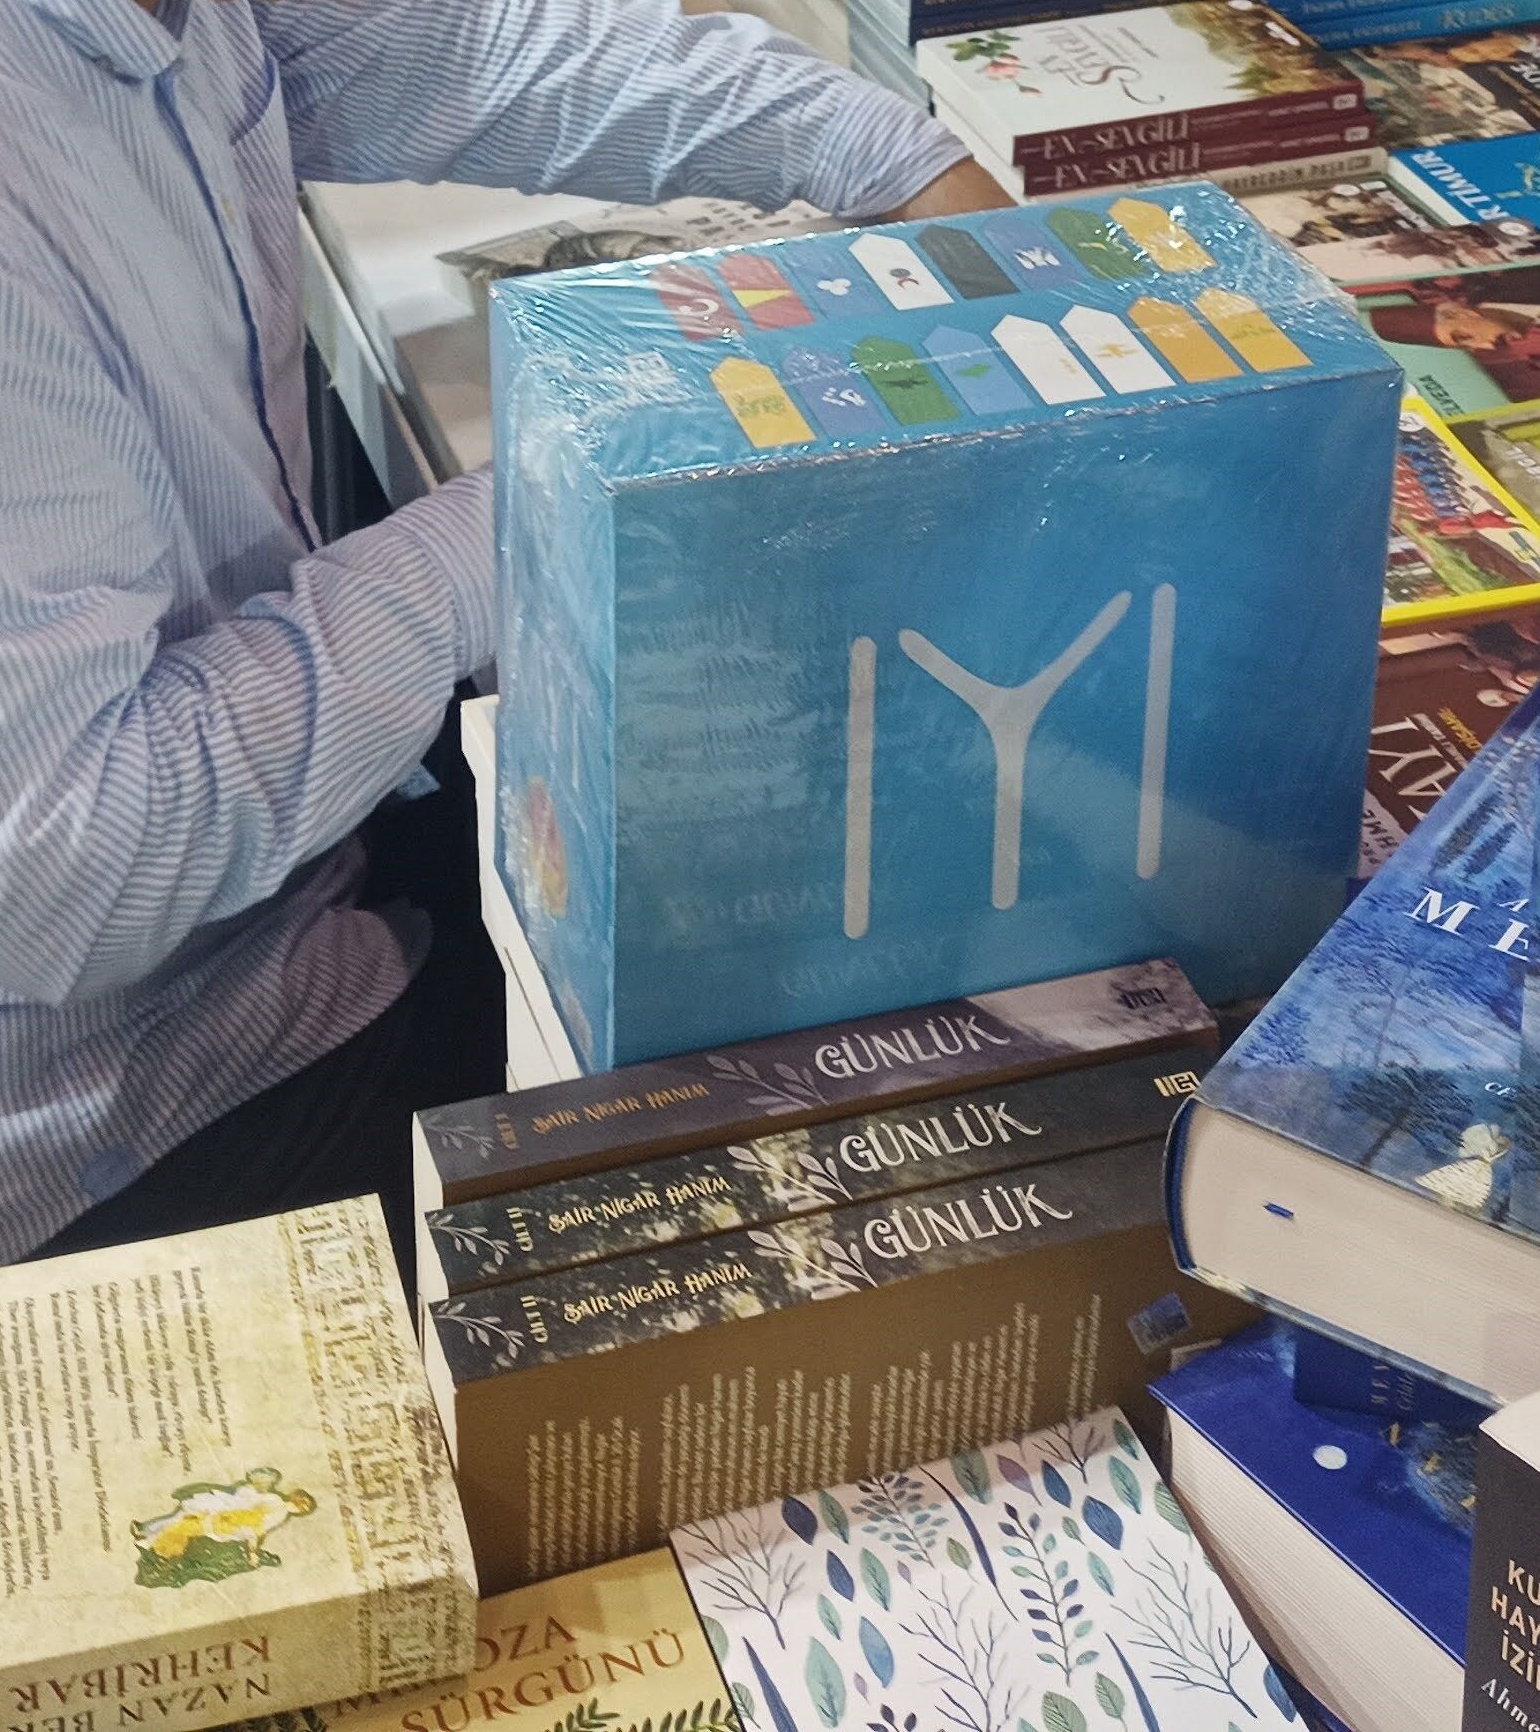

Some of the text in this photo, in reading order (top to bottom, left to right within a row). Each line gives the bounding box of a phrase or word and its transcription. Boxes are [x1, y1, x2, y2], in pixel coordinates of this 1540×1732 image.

[1412, 149, 1492, 209] TİMUR
[814, 1014, 1012, 1081] GÜNLÜK
[838, 1101, 1043, 1174] GÜNLÜK
[862, 1182, 1074, 1262] GÜNLÜK
[13, 1634, 273, 1718] KEHRİBAR
[112, 1671, 273, 1728] NAZAN
[401, 1629, 689, 1732] SÜRGÜNÜ
